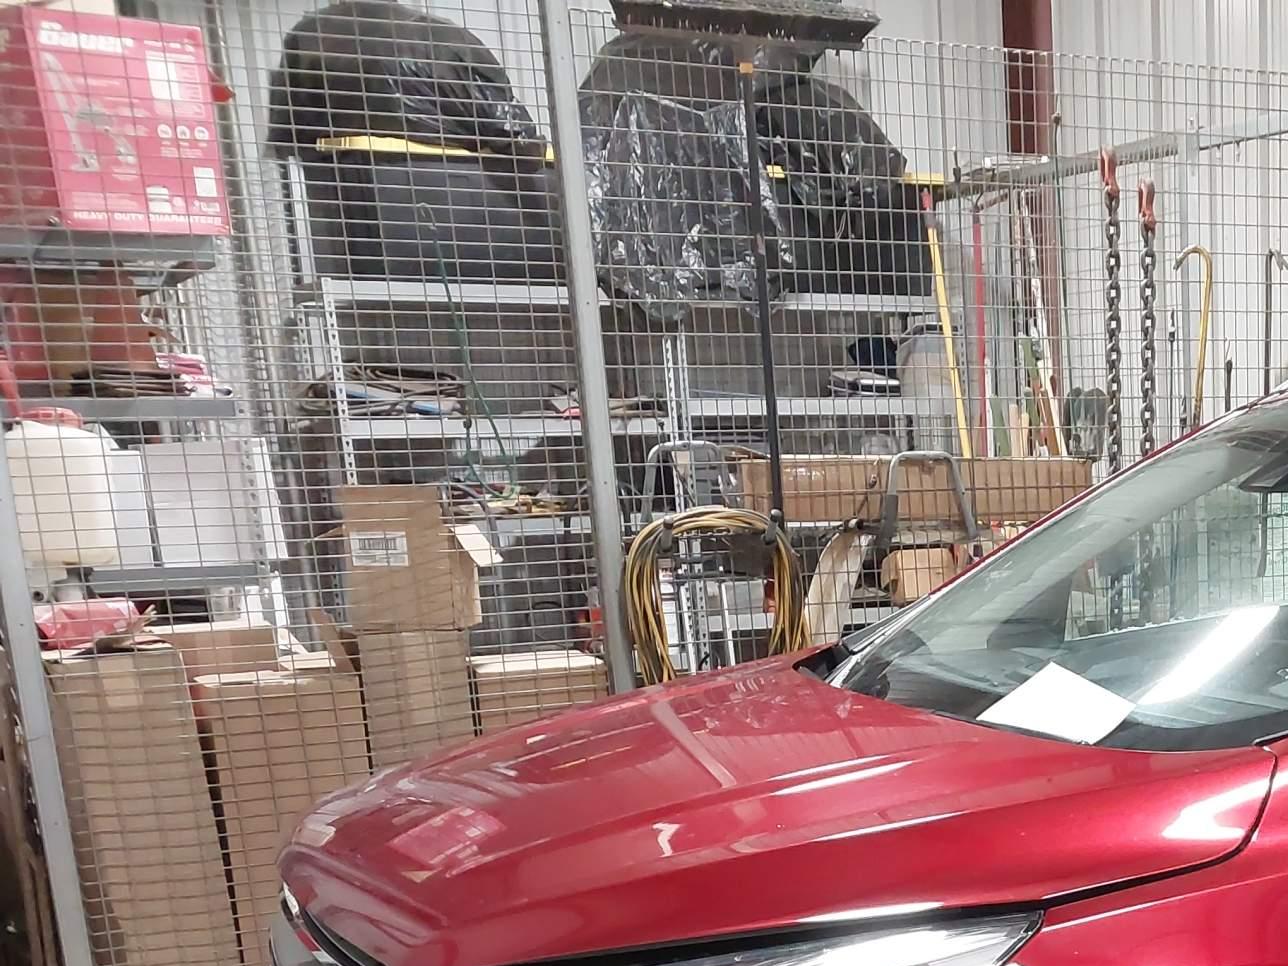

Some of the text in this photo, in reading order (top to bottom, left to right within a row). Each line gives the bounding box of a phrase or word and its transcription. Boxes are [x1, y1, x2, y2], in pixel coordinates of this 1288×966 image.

[38, 21, 134, 54] Bauer
[73, 210, 109, 221] HEAVY
[114, 212, 145, 222] DUTY
